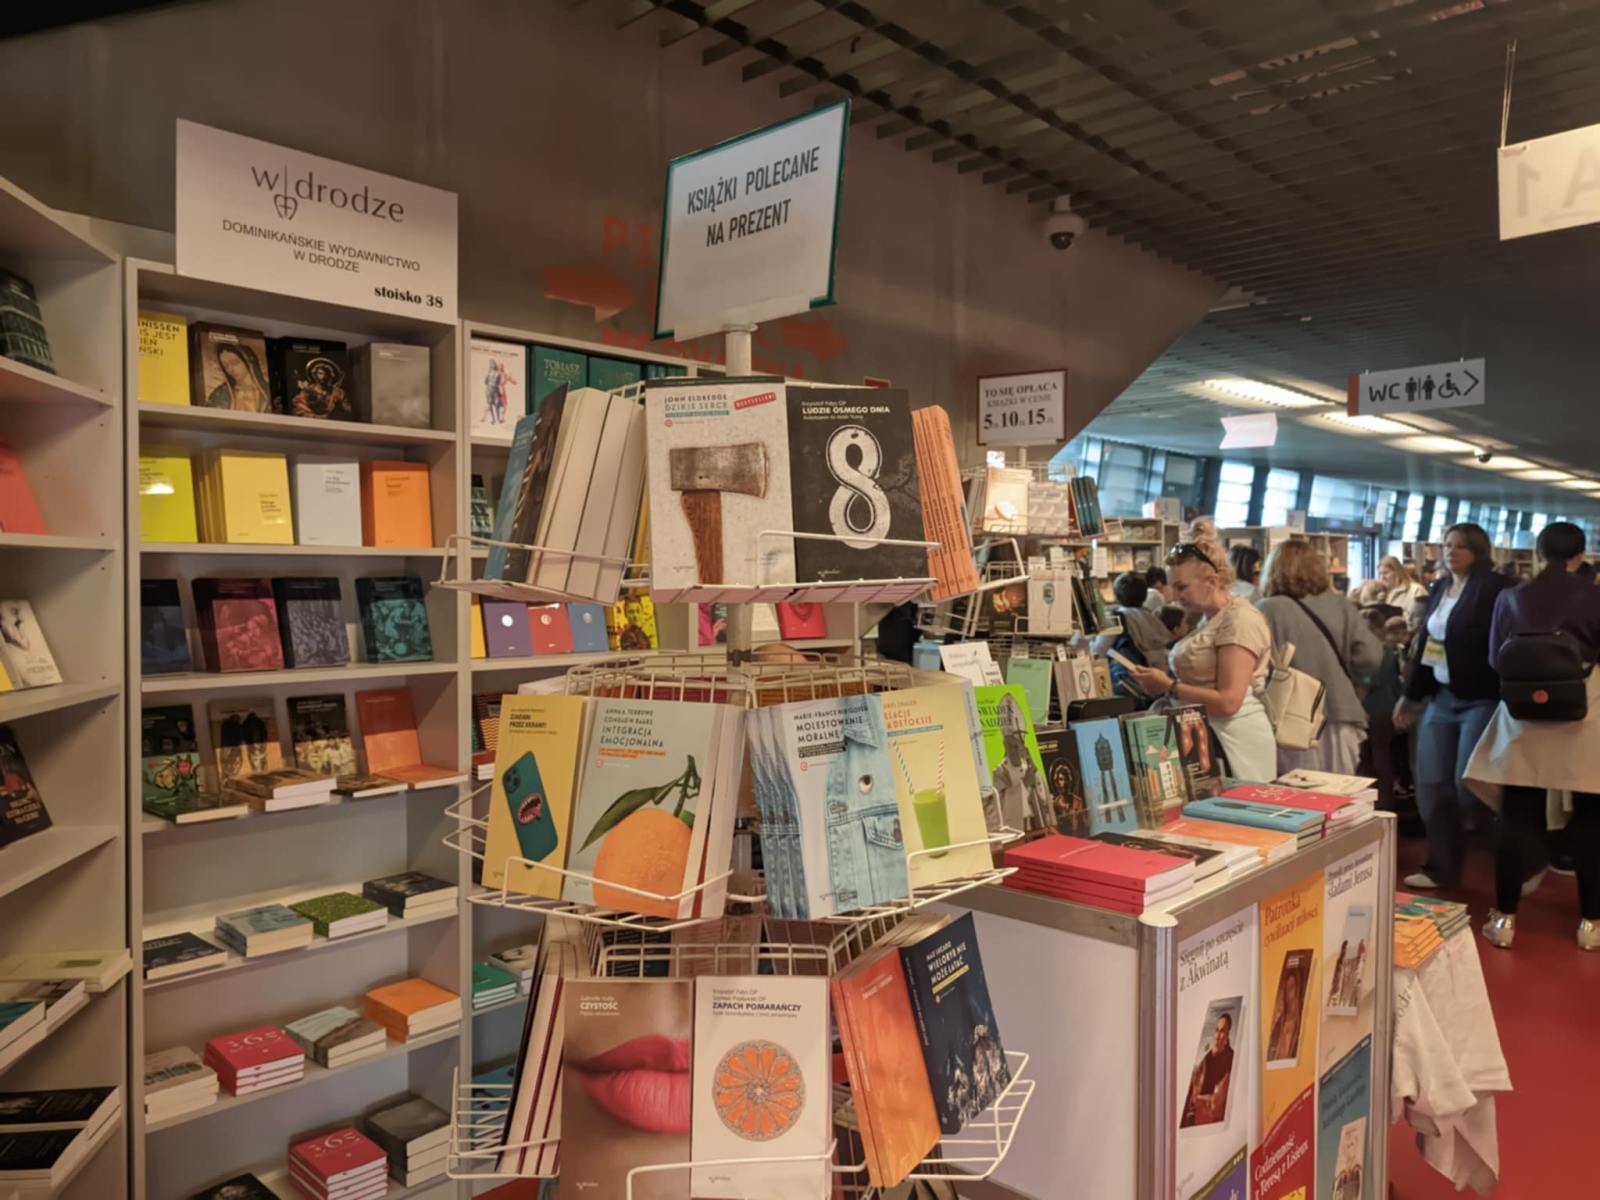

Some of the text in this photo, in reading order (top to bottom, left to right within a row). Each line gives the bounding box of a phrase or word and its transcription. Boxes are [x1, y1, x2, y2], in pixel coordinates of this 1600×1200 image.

[687, 146, 820, 215] KSIĄŻKI POLECANE
[294, 171, 406, 223] drodze
[706, 198, 792, 248] NA PREZENT
[222, 218, 421, 273] DOMINIKAŃSKIE WYDAWNICTWO
[293, 249, 360, 274] W DRODZE
[374, 285, 444, 309] stoisko 38
[984, 388, 998, 399] TO
[1368, 382, 1400, 402] WC
[983, 407, 1046, 430] 5 10 15
[602, 725, 652, 737] INTEGRACJA
[796, 715, 863, 732] MOLESTOWANIE
[600, 736, 664, 748] EMOCJONALNA
[798, 729, 840, 744] MORALNE
[712, 1002, 802, 1012] ZAPACH POMARAŃCZY
